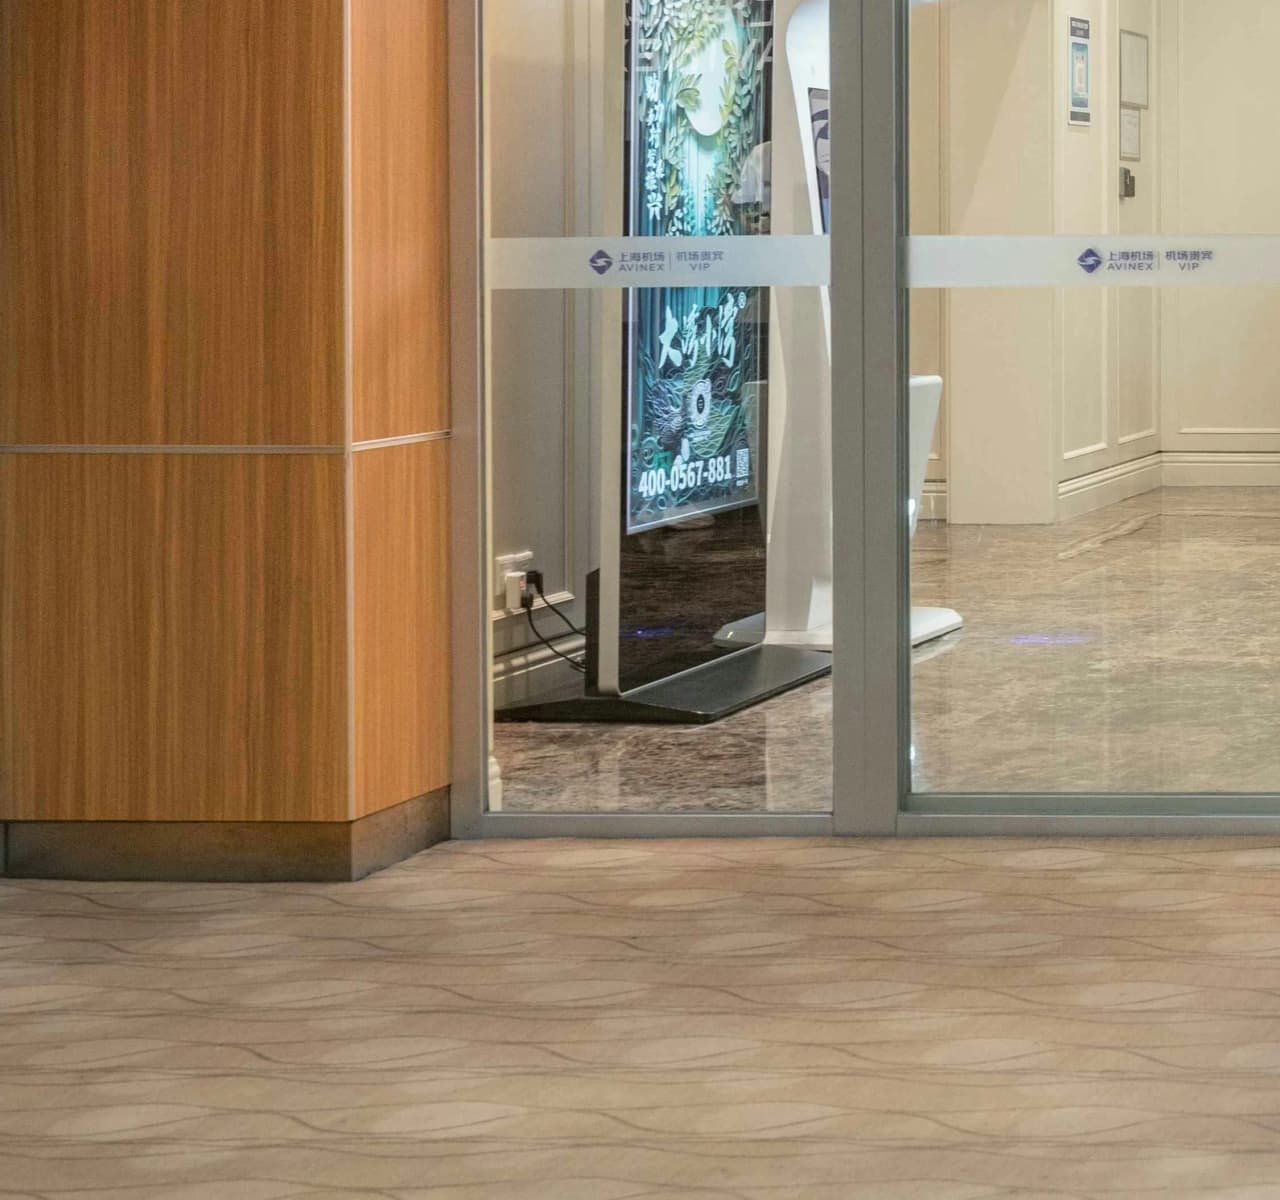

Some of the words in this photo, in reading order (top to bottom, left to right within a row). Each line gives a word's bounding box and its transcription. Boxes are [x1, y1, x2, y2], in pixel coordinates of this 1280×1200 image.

[618, 252, 664, 262] 上海机场
[1108, 251, 1154, 261] 上海机场
[618, 263, 664, 271] AVINEX
[689, 263, 711, 271] VIP
[1107, 262, 1153, 271] AVINEX
[1178, 262, 1200, 271] VIP
[638, 455, 731, 498] 400-0567-881
